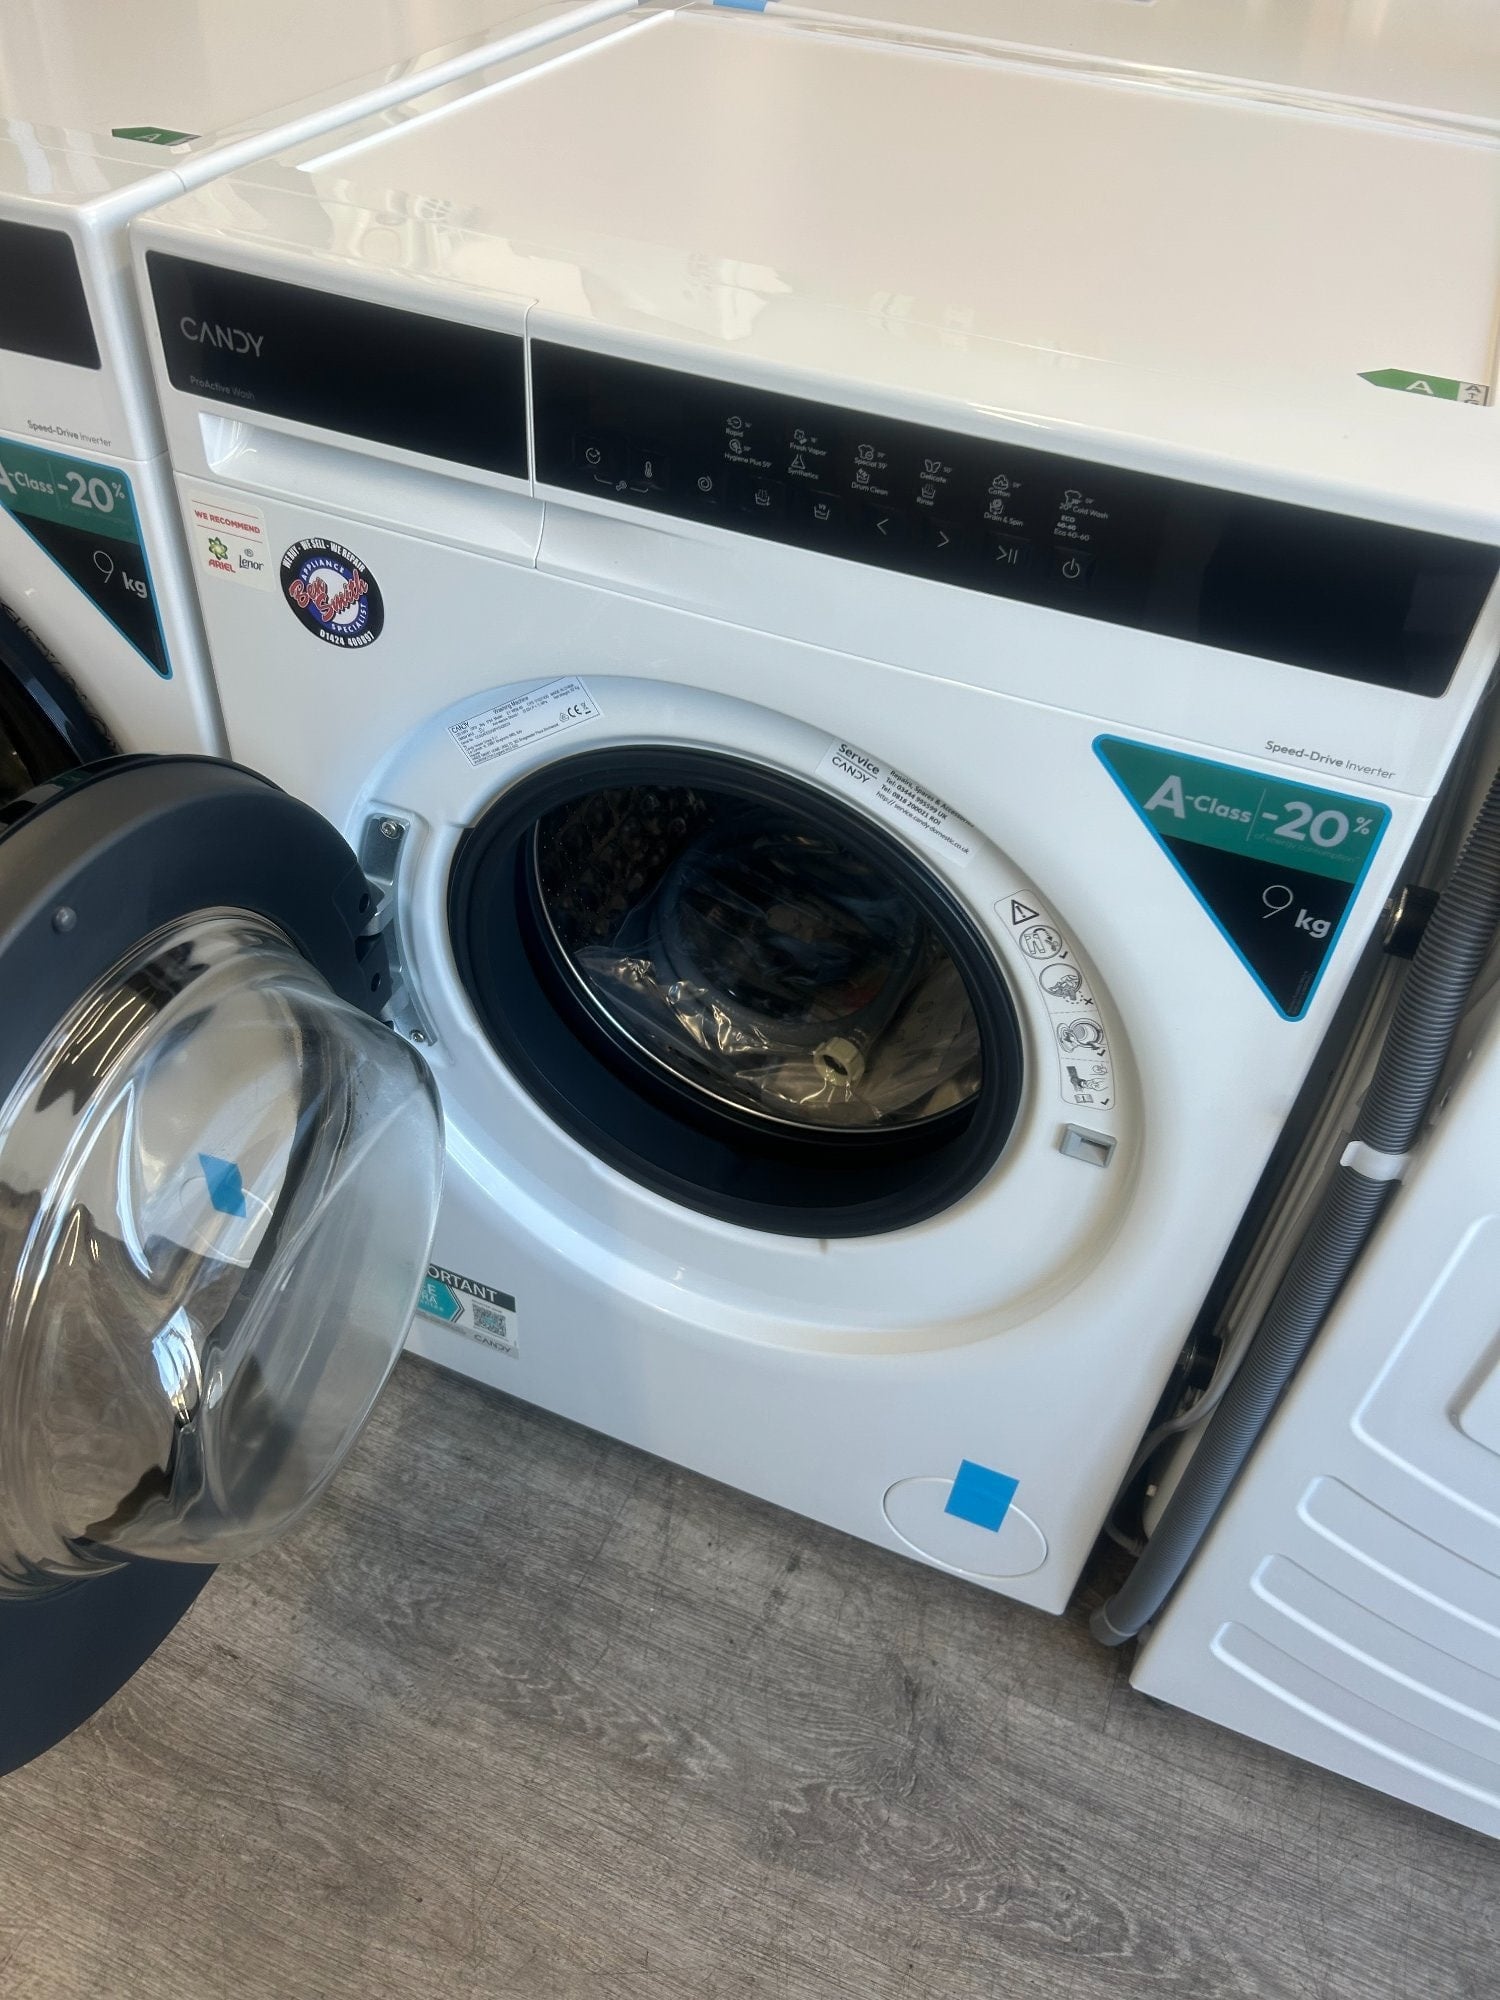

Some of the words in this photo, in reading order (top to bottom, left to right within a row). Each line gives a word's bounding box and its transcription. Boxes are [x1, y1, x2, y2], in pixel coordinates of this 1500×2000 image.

[180, 316, 264, 358] CANDY
[190, 375, 231, 395] ProActive
[231, 387, 256, 400] Wash
[1406, 380, 1433, 394] A
[27, 419, 79, 440] Speed-Drive
[80, 432, 112, 448] Inverter
[788, 467, 820, 480] Synthetics
[854, 457, 877, 469] Special
[851, 482, 870, 492] Drum
[870, 486, 889, 497] Clean
[920, 472, 947, 484] Delicate
[988, 487, 1011, 498] Cotton
[194, 509, 209, 521] WE
[209, 514, 261, 534] RECOMMEND
[984, 511, 1002, 522] Drain
[1072, 506, 1089, 516] Cold
[1090, 509, 1109, 520] Wash
[93, 550, 114, 584] 9
[208, 559, 237, 574] ARIEL
[239, 554, 265, 571] Lenor
[286, 545, 300, 560] BUY
[310, 538, 327, 550] SELL
[341, 548, 366, 573] REPAIR
[301, 559, 345, 581] APPLIANCE
[121, 571, 148, 598] kg
[288, 577, 328, 609] Ben
[315, 568, 369, 622] Smith
[331, 603, 367, 633] SPECIALIST
[320, 629, 345, 646] 01424
[832, 756, 870, 783] CANDY
[838, 743, 880, 775] Service
[1265, 740, 1343, 767] Speed-Drive
[1345, 759, 1397, 779] Inverter
[881, 784, 892, 795] Tel:
[929, 816, 941, 826] ROI
[886, 777, 897, 788] Tel:
[896, 784, 915, 799] 03444
[937, 811, 948, 820] UK
[914, 785, 935, 802] Spares
[1143, 775, 1252, 823] A-Class
[1261, 885, 1294, 919] 9
[1294, 909, 1332, 939] kg
[427, 1265, 498, 1303] ORTANT
[474, 1334, 511, 1353] CANDY
